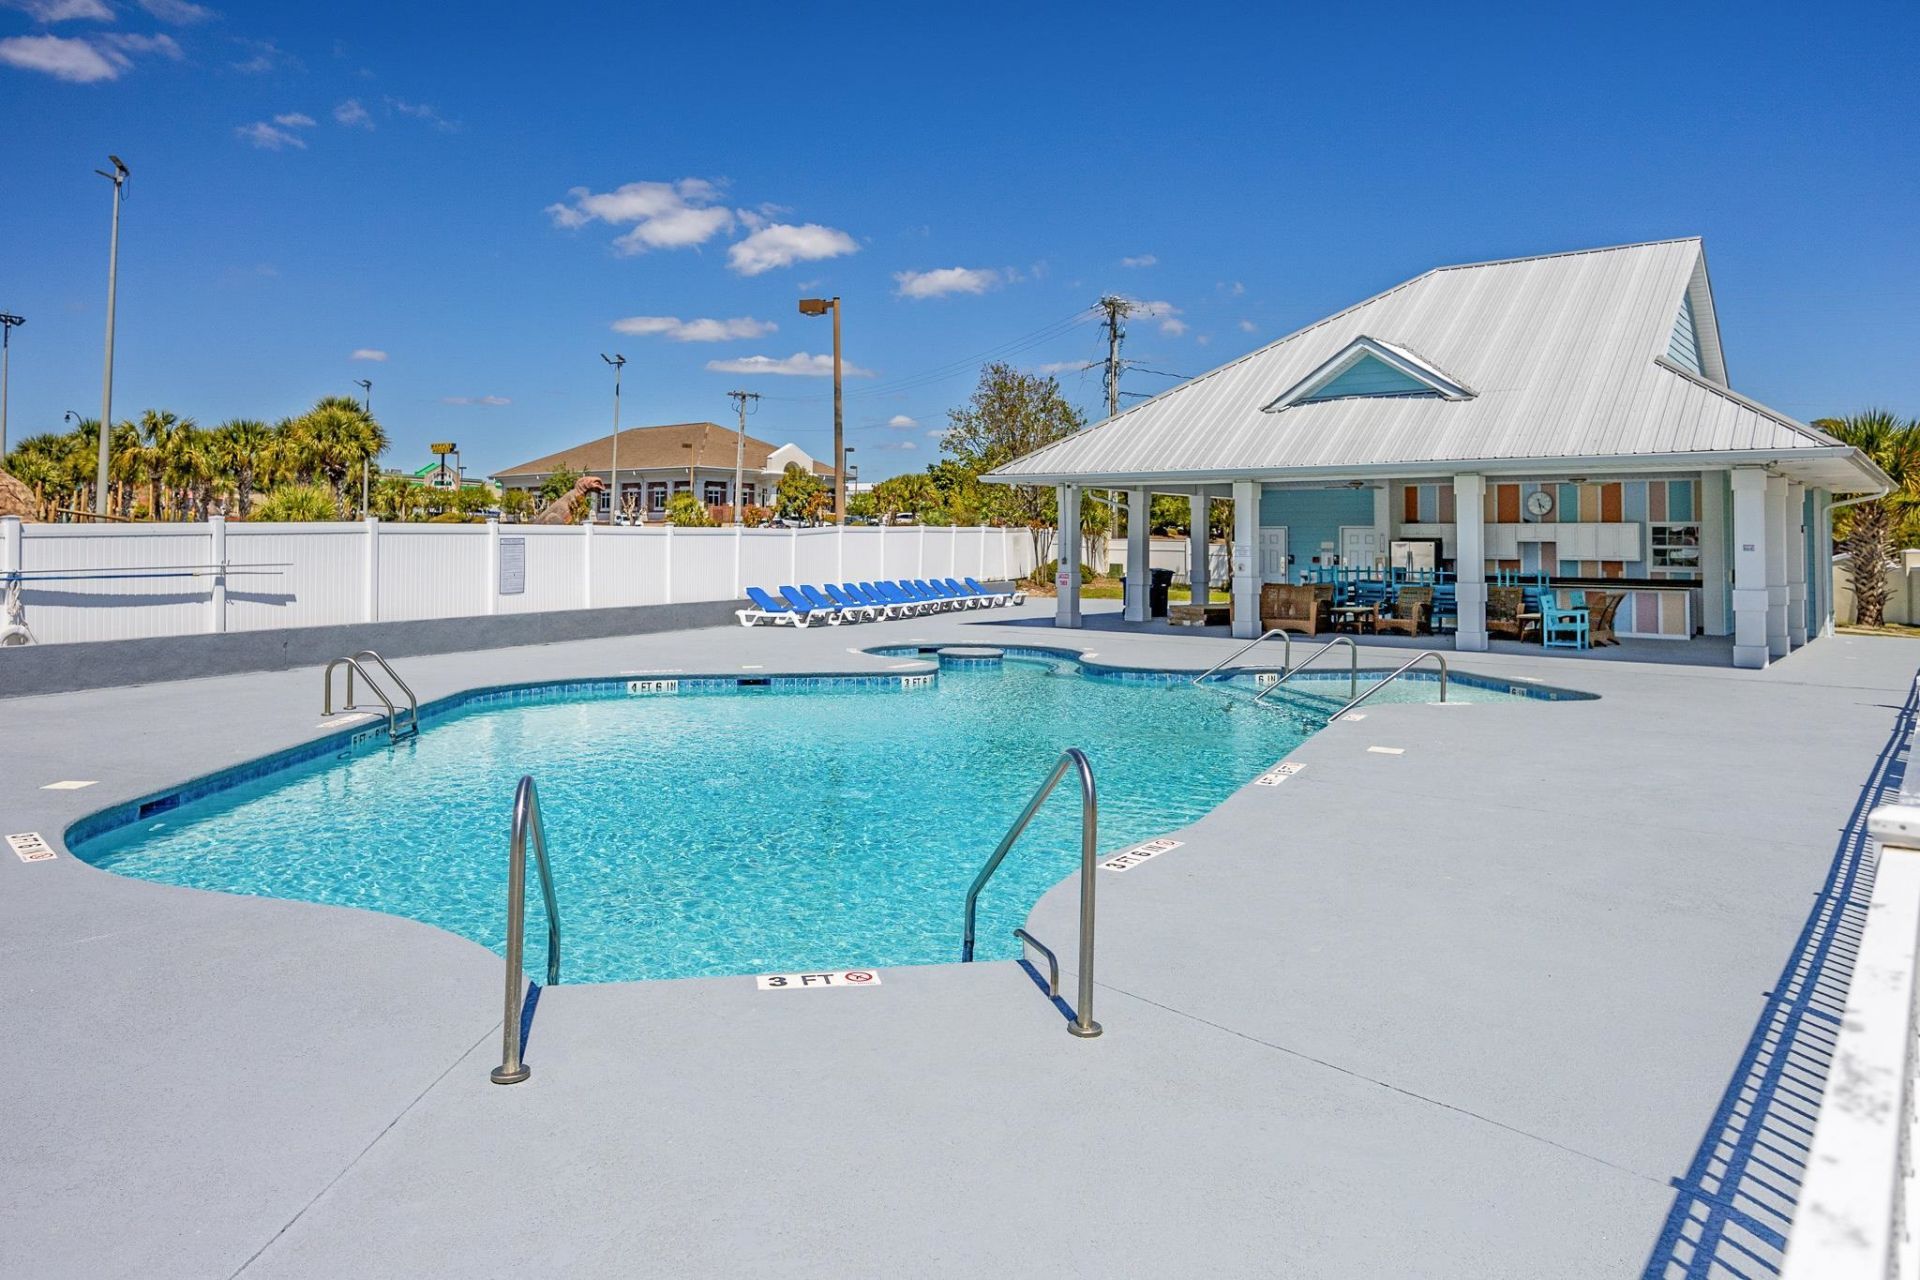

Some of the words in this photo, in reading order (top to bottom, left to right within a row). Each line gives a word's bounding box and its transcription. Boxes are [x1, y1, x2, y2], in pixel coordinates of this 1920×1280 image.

[631, 682, 637, 692] 4
[641, 682, 652, 692] FT
[655, 681, 662, 692] 6
[666, 681, 676, 691] IN
[912, 677, 922, 687] FT
[1115, 855, 1141, 865] FT
[1105, 862, 1127, 870] 3
[768, 976, 788, 987] 3
[801, 974, 834, 986] FT
